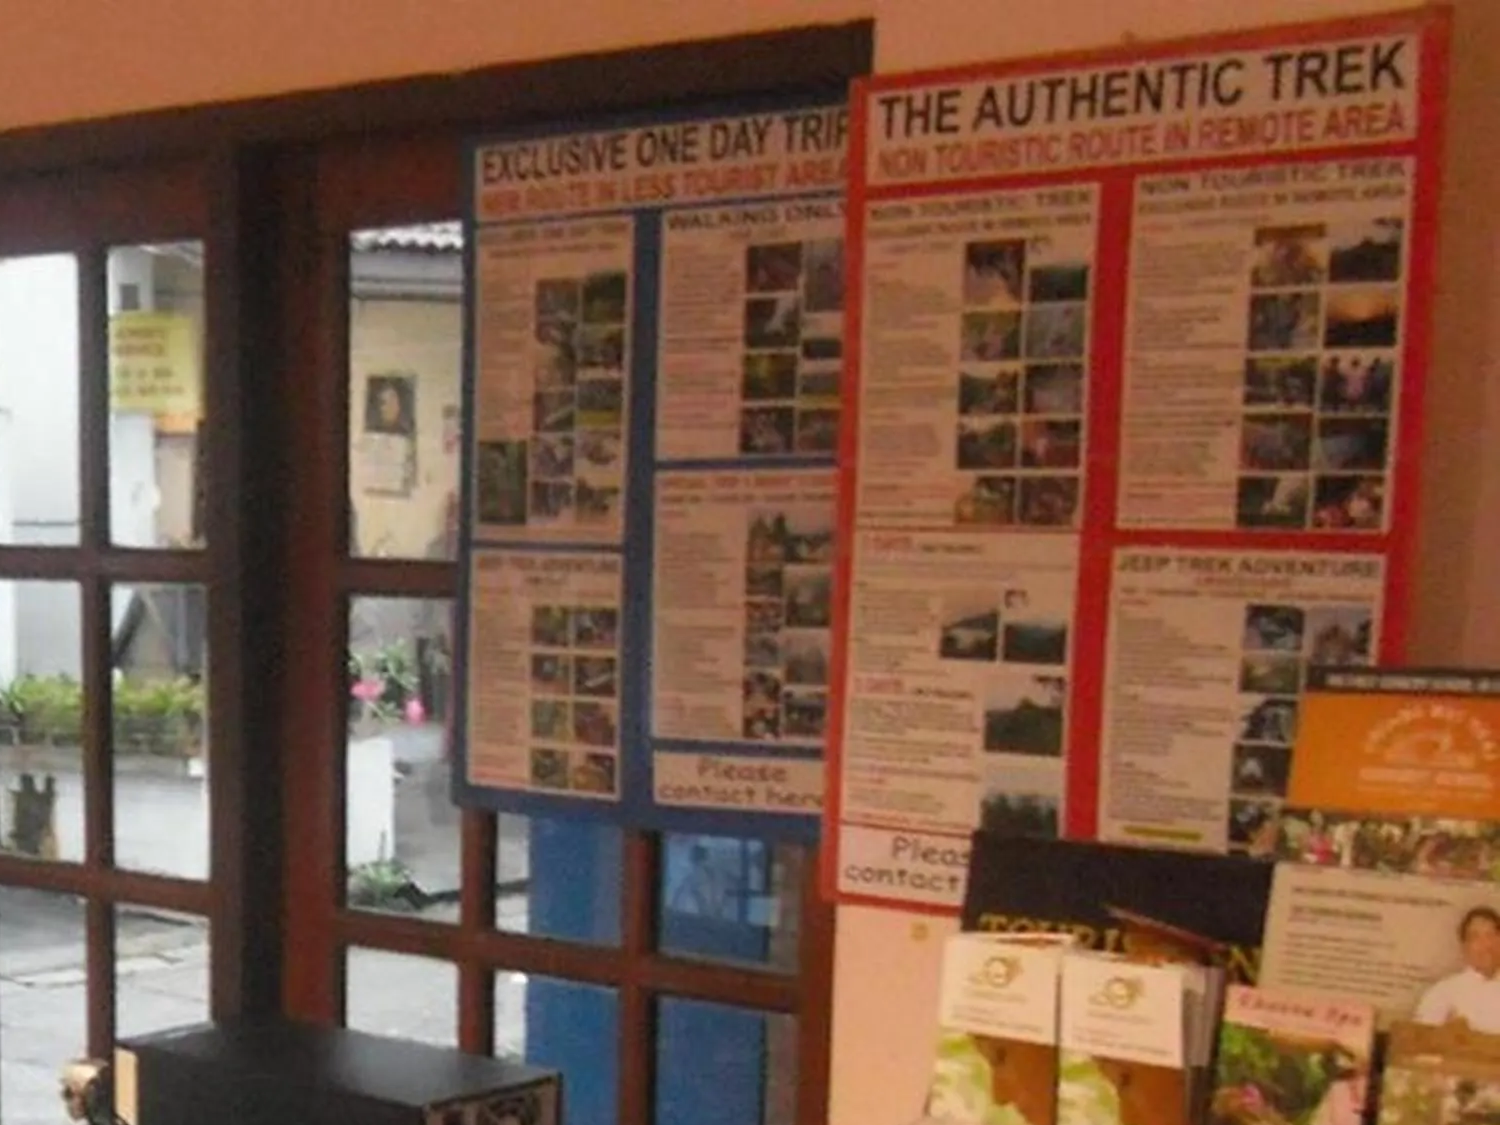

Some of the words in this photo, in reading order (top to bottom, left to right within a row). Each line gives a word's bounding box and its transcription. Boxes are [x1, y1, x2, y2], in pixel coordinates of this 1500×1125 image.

[878, 89, 962, 139] THE
[972, 57, 1244, 132] AUTHENTIC
[1263, 40, 1406, 101] TREK
[483, 133, 628, 184] EXCLUSIVE
[636, 126, 699, 168] ONE
[711, 117, 773, 160] DAY
[878, 147, 927, 178] NON
[934, 133, 1062, 174] TOURISTIC
[1069, 123, 1157, 164] ROUTE
[1164, 120, 1191, 151] IN
[1200, 108, 1317, 148] REMOTE
[1322, 98, 1405, 139] AREA
[623, 173, 675, 203] LESS
[683, 163, 779, 196] TOURIST
[844, 864, 959, 893] contact
